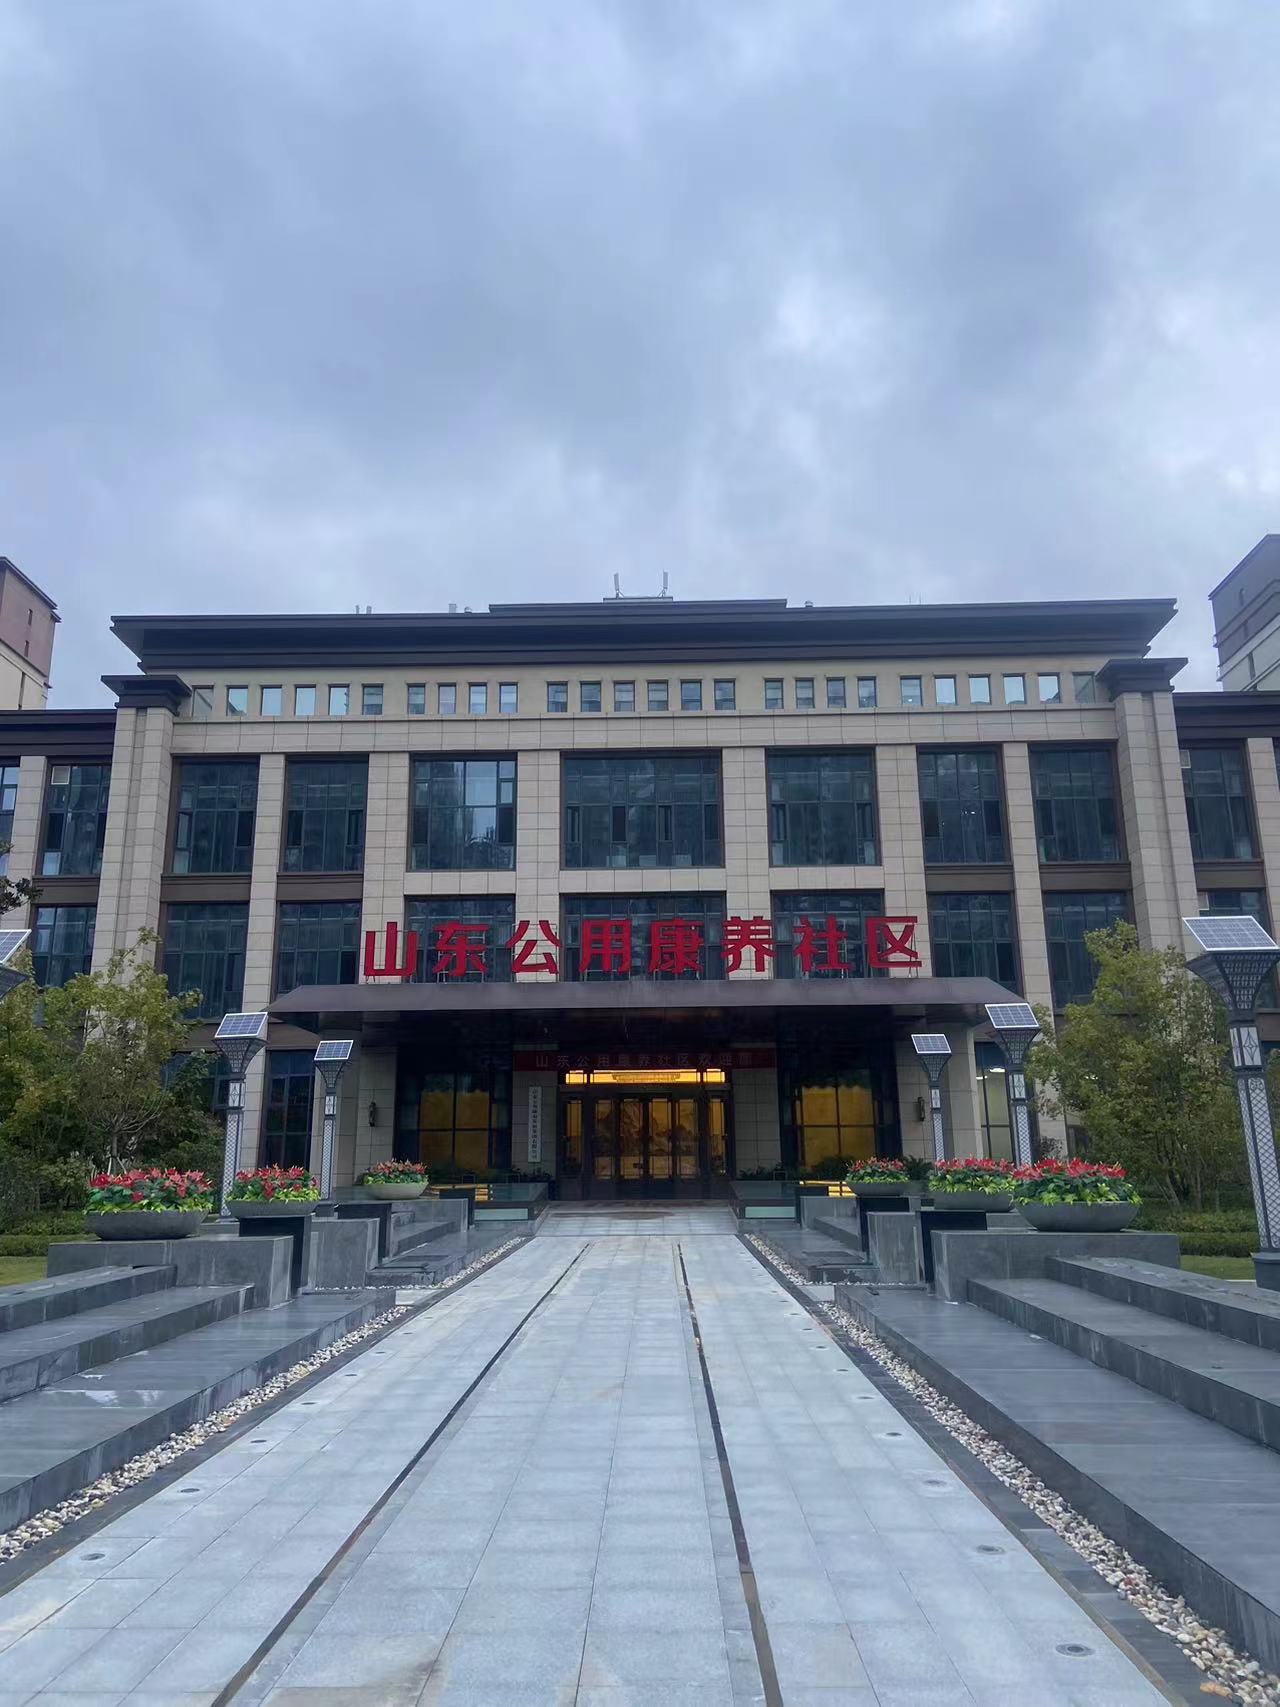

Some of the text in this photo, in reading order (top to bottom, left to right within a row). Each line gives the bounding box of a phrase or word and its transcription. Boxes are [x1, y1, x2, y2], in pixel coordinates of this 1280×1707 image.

[364, 916, 922, 977] 山东公用康养社区
